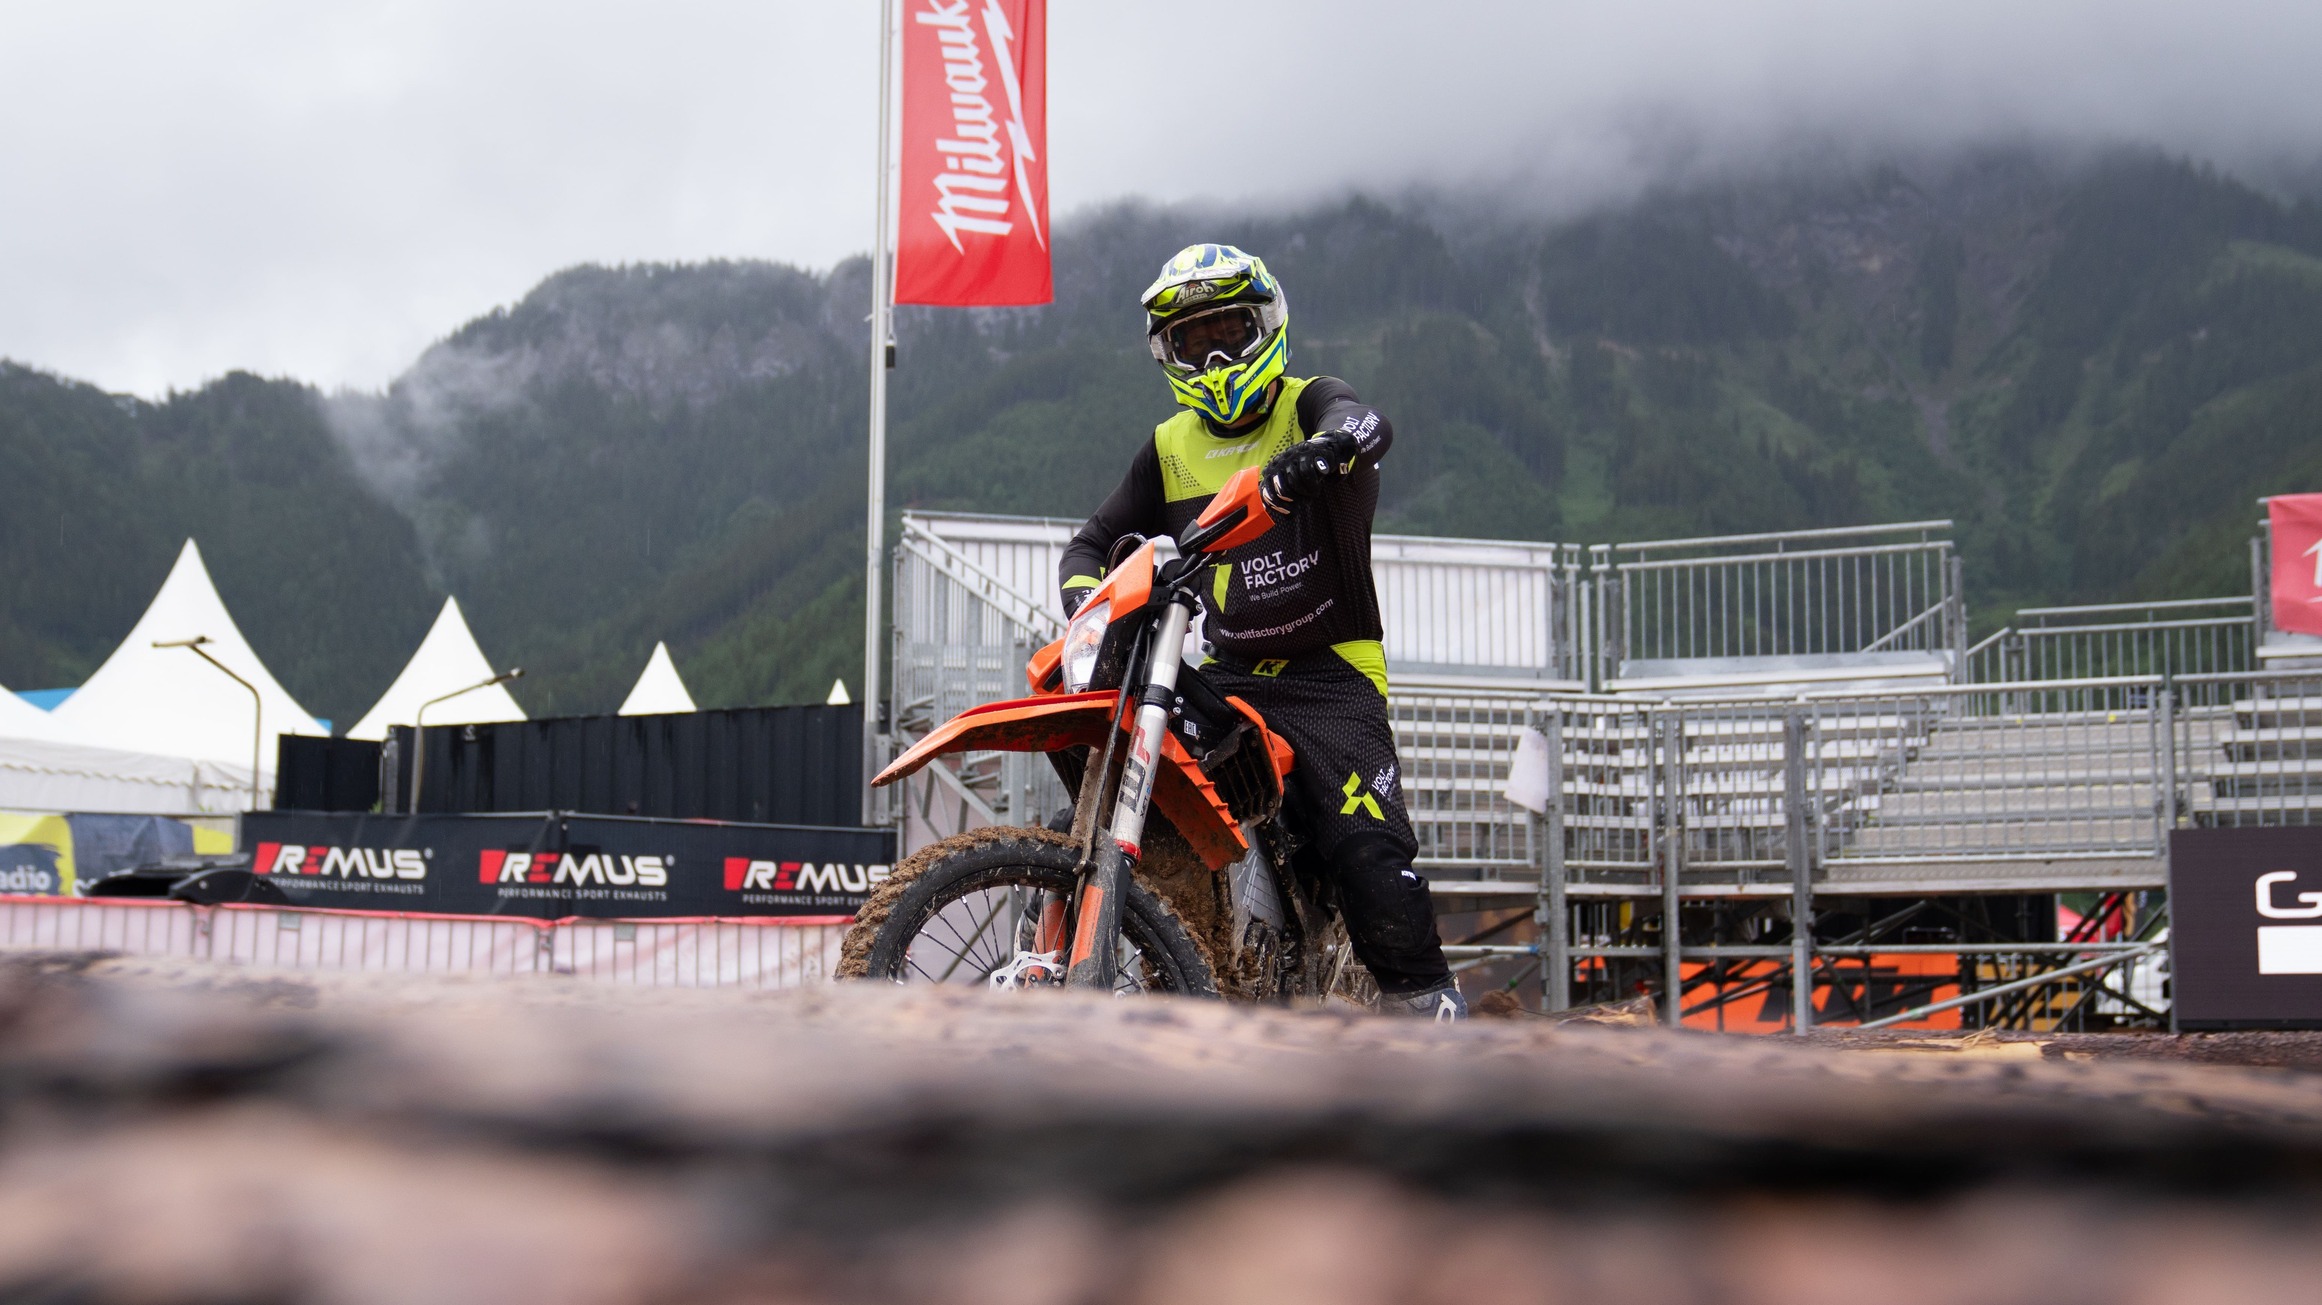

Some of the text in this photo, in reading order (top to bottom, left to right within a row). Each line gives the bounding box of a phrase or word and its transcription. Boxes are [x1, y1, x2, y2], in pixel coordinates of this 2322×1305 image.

[1176, 281, 1215, 304] Airoh
[1352, 410, 1380, 444] FACTORY
[1241, 551, 1283, 575] VOLT
[1244, 550, 1319, 590] FACTORY
[1249, 593, 1261, 602] We
[1261, 588, 1279, 600] Build
[1371, 768, 1386, 791] VOLT
[1379, 763, 1395, 798] FACTORY
[341, 881, 371, 893] SPORT
[374, 883, 425, 896] EXHAUSTS
[497, 887, 668, 902] PERFORMANCE SPORT EXHAUSTS
[742, 893, 812, 906] PERFORMANCE
[814, 896, 846, 907] SPORT
